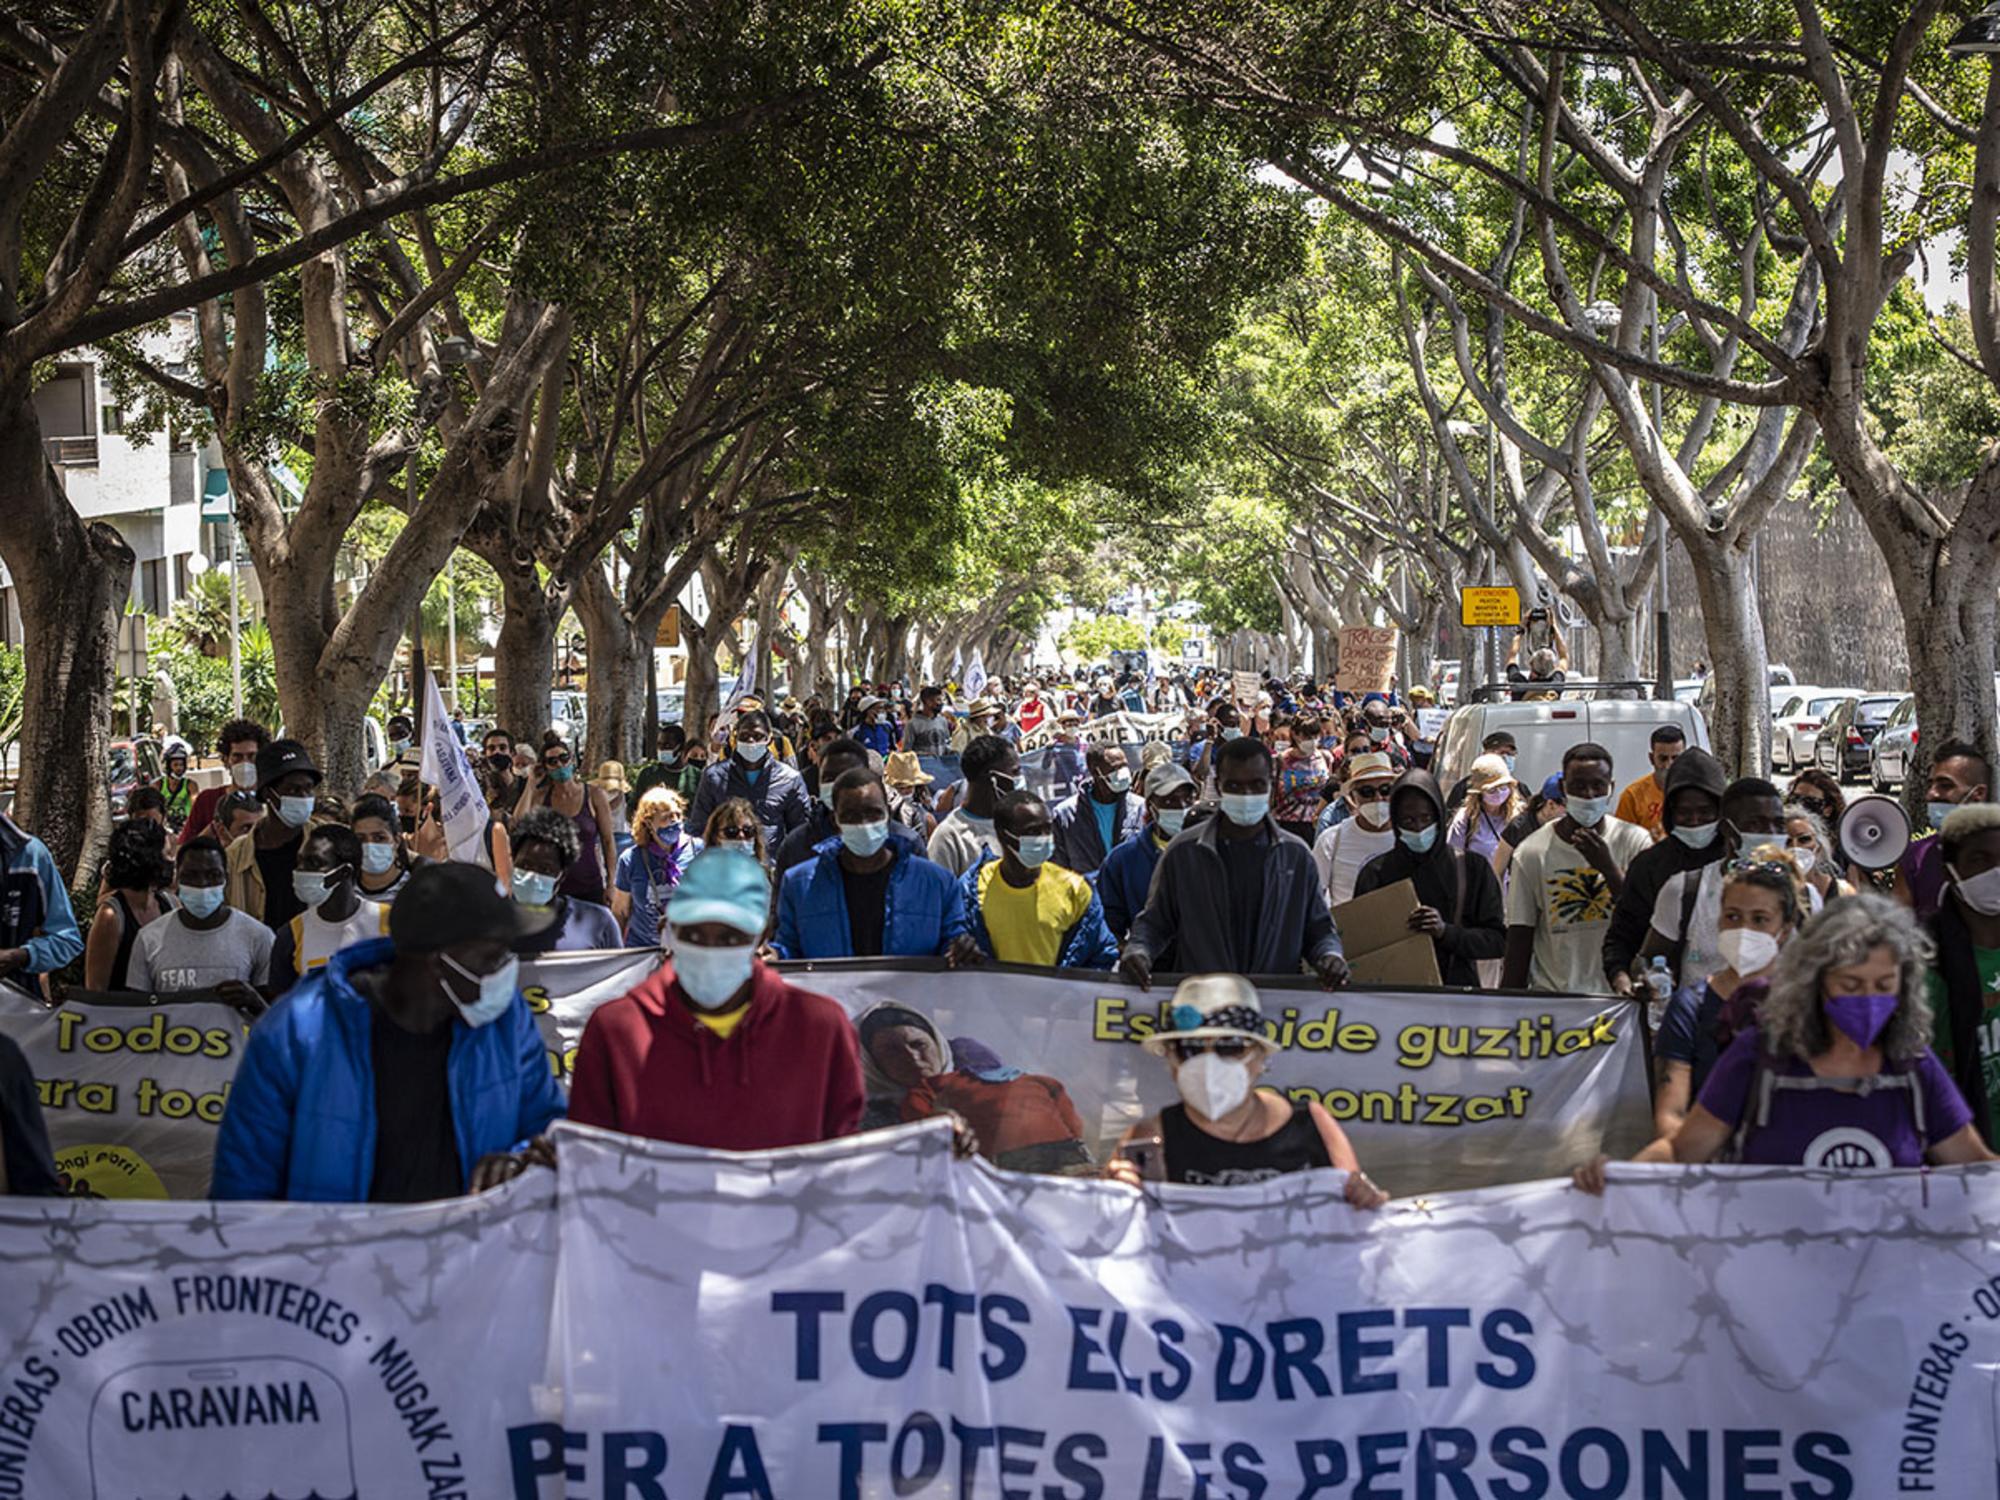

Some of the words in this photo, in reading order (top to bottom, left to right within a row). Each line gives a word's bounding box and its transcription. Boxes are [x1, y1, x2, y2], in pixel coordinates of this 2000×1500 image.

[160, 969, 197, 987] FEAR
[57, 1010, 232, 1057] Todos
[1397, 1014, 1617, 1068] guztiak
[56, 1285, 159, 1358] OBRIM
[172, 1274, 361, 1347] FRONTERES
[368, 1335, 454, 1454] MUGAK
[770, 1284, 1031, 1382] TOTS
[1066, 1305, 1193, 1401] ELS
[1213, 1307, 1537, 1402] DRETS
[119, 1380, 321, 1434] CARAVANA
[1897, 1321, 1970, 1492] FRONTERAS
[506, 1421, 668, 1500] PER
[703, 1423, 778, 1500] A
[816, 1410, 1109, 1500] TOTES
[1140, 1435, 1270, 1500] LES
[1294, 1426, 1854, 1500] PERSONES
